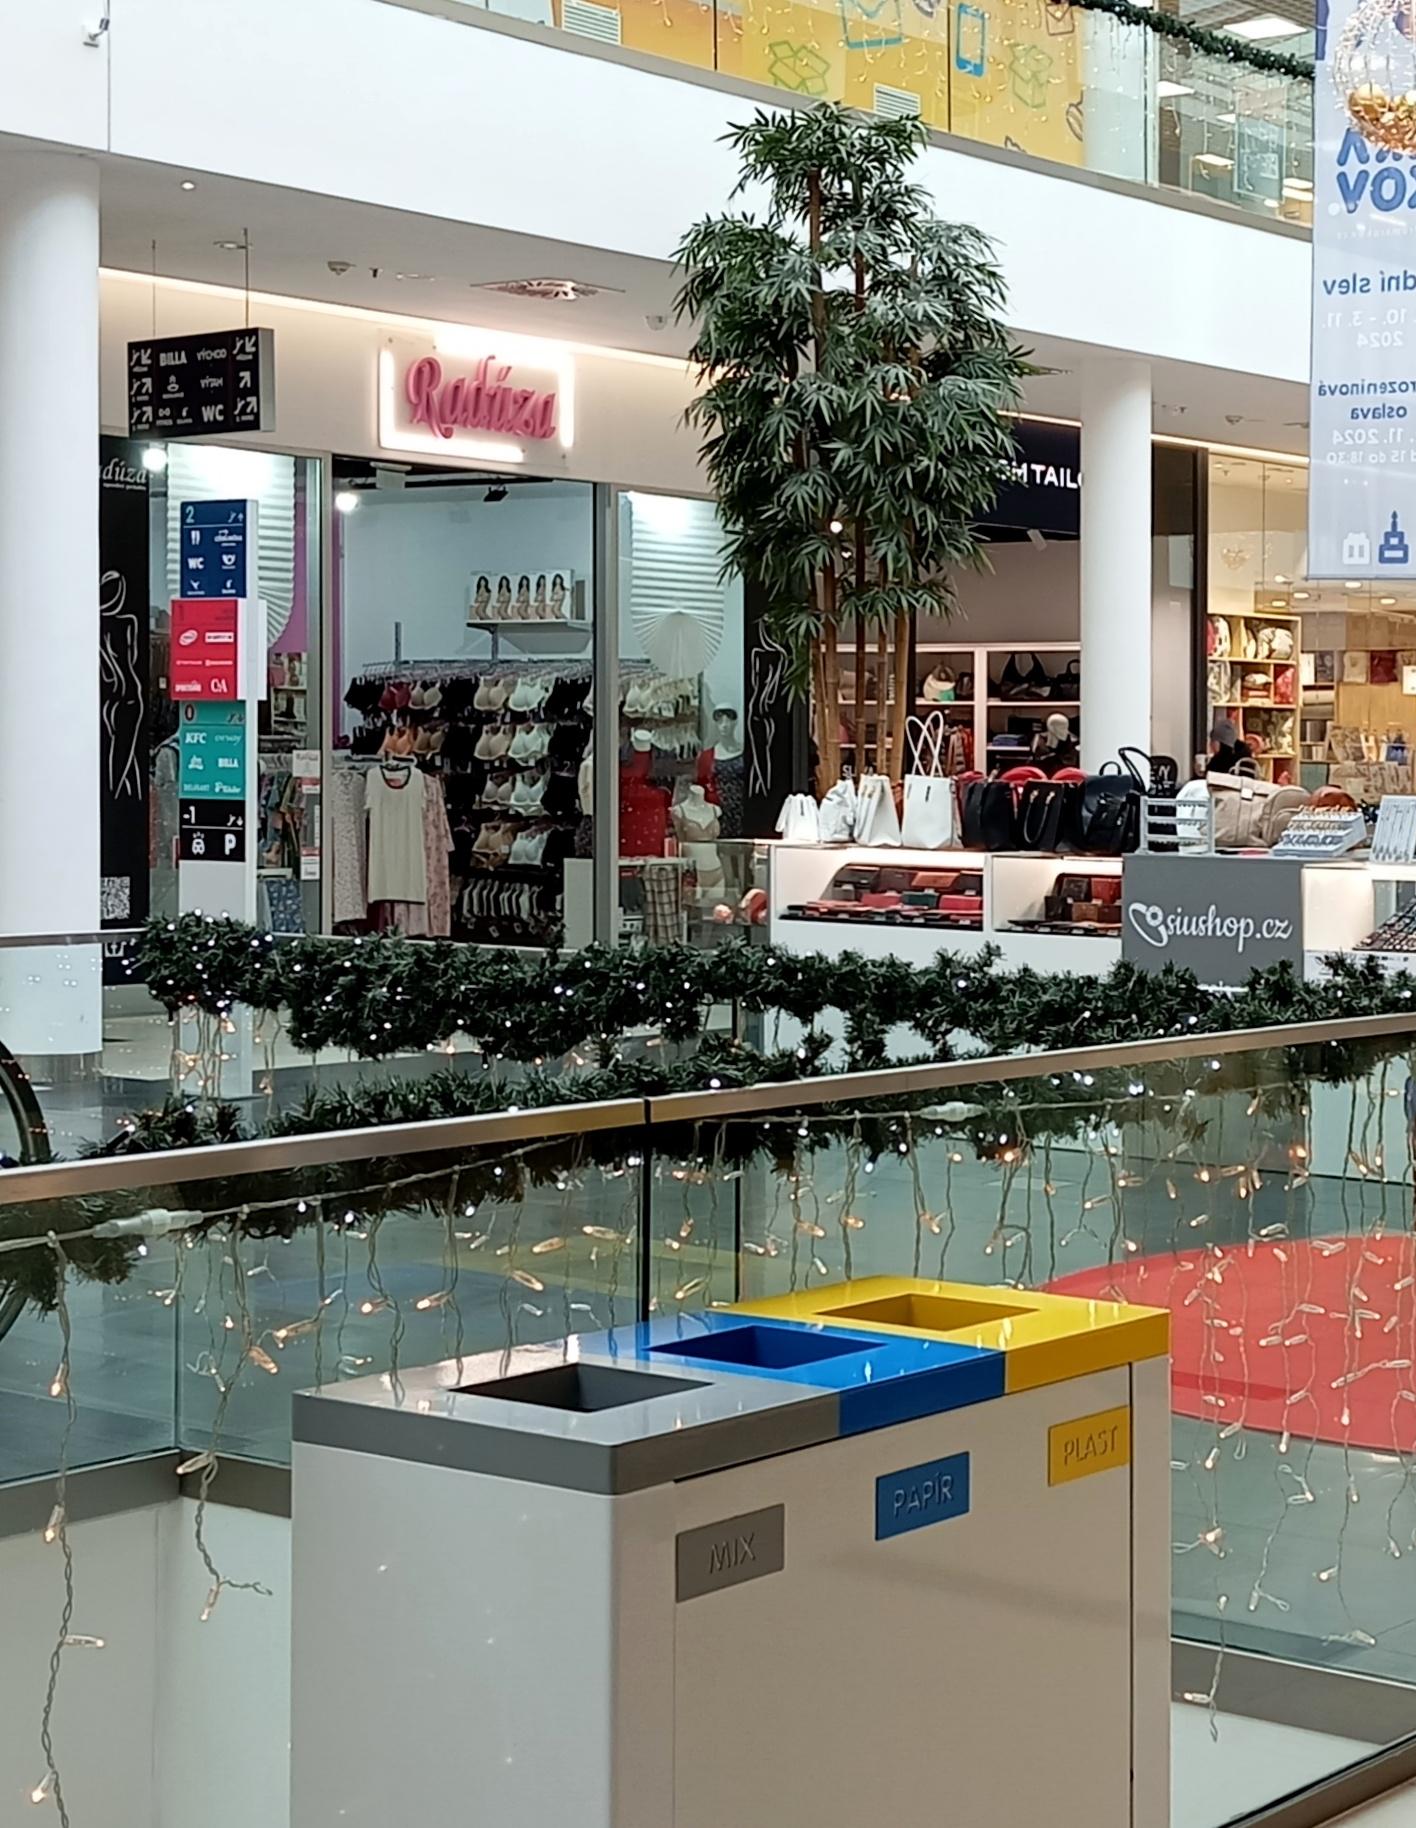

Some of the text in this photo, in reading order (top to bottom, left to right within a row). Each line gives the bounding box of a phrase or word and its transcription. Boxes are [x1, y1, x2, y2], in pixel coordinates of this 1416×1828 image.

[159, 351, 187, 367] BILLA
[407, 355, 556, 440] Radúza
[201, 404, 225, 423] WC
[101, 457, 147, 483] dúza
[1030, 463, 1083, 489] TAIL
[185, 505, 195, 524] 2
[187, 556, 205, 570] WC
[184, 731, 207, 744] KFC
[182, 805, 196, 824] -1
[224, 833, 236, 856] P
[1166, 904, 1293, 953] siushop.cz
[1064, 1425, 1118, 1467] PLAST
[893, 1472, 953, 1519] PAPÍR
[709, 1532, 756, 1574] MIX
